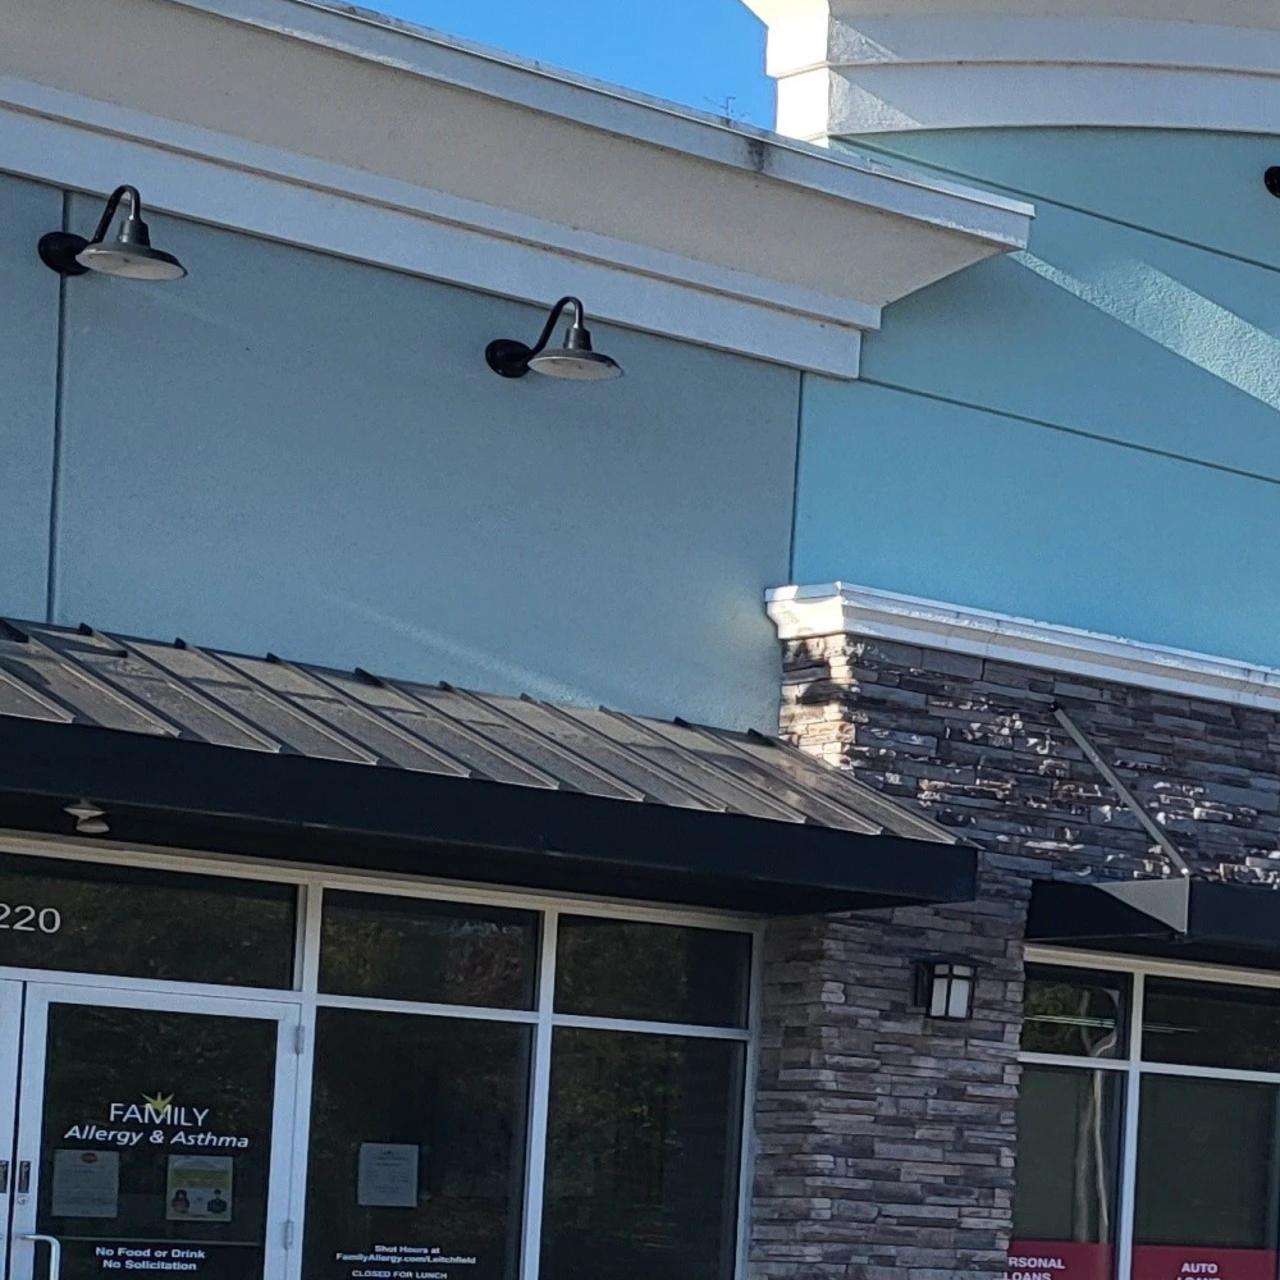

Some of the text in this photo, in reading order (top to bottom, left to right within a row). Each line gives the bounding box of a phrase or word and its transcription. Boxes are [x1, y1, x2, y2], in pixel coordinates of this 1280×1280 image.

[109, 1102, 209, 1127] FAMILY
[64, 1125, 250, 1148] Allergy & Asthma
[95, 1247, 205, 1259] No Food or Drink
[103, 1259, 197, 1271] No Solicitation
[1008, 1256, 1066, 1270] RSONAL
[1181, 1262, 1218, 1274] AUTO
[352, 1270, 391, 1278] CLOSED
[415, 1271, 447, 1279] LUNCH
